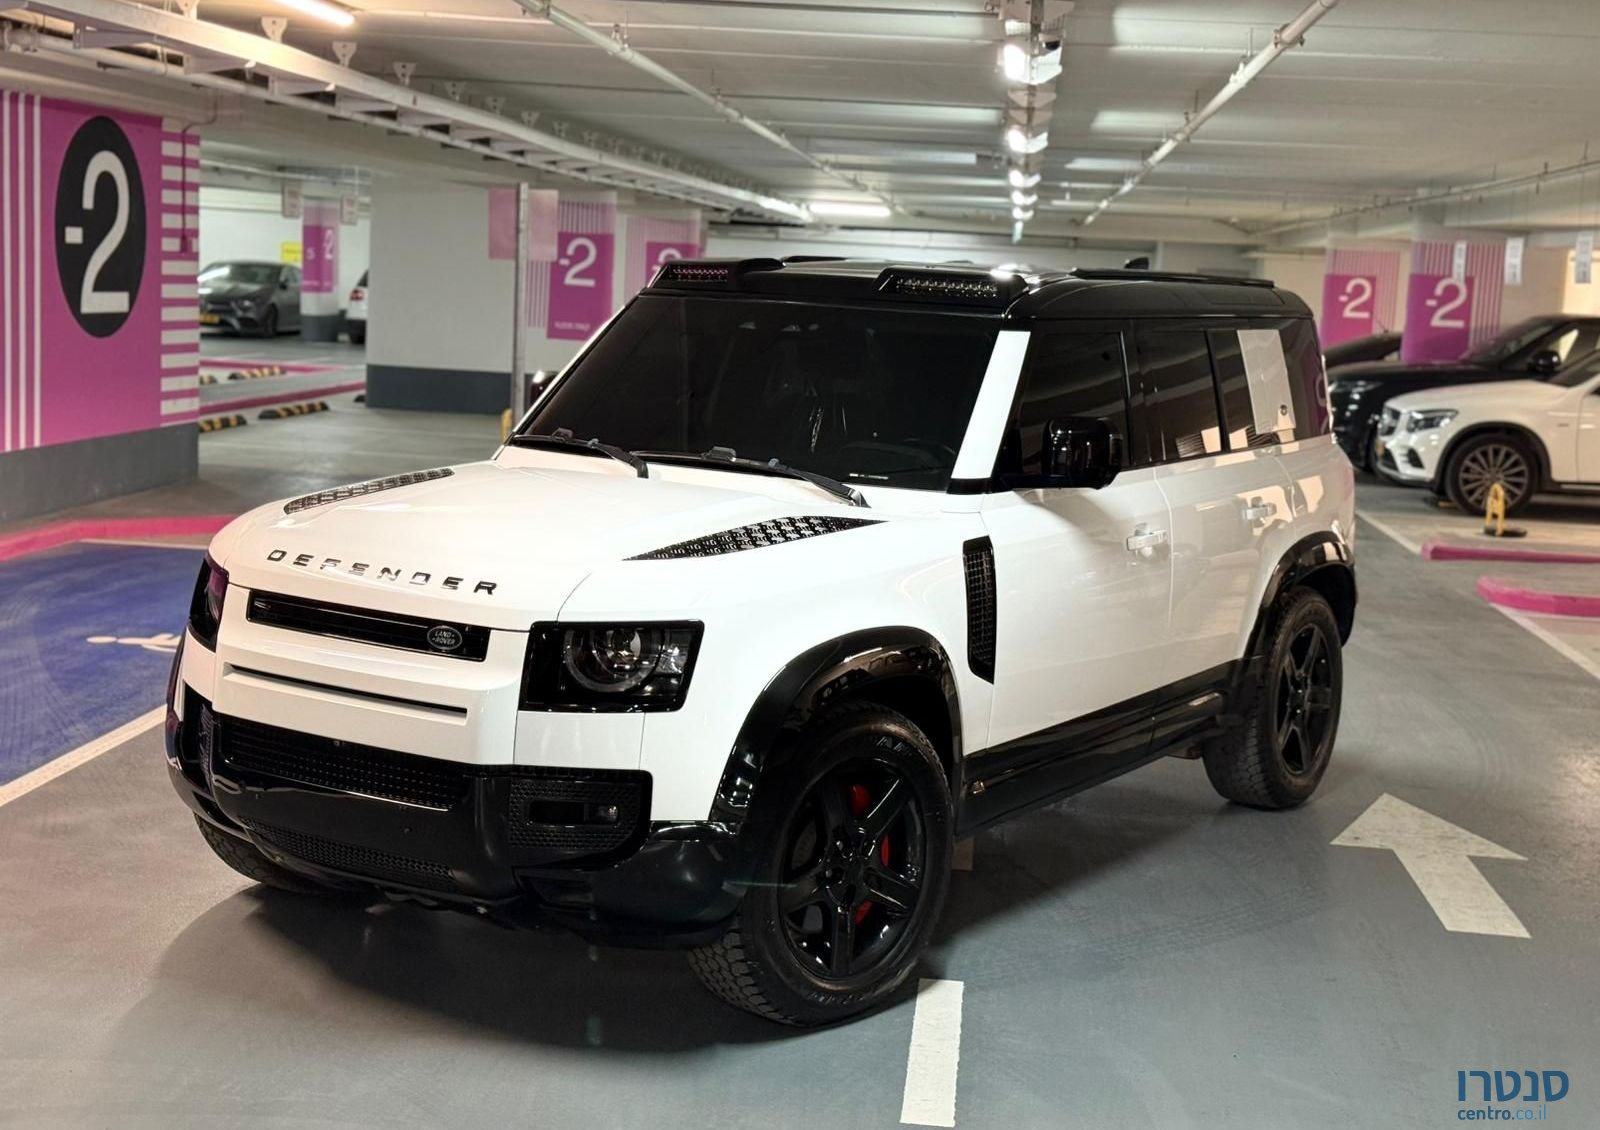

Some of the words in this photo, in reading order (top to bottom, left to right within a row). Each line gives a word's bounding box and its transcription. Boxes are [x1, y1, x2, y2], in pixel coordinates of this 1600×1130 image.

[64, 150, 130, 315] -2
[559, 237, 598, 288] -2
[1338, 277, 1372, 319] -2
[1425, 277, 1468, 328] -2
[266, 548, 498, 596] DEFENDER
[434, 630, 452, 638] LAND
[434, 636, 456, 645] ROVER
